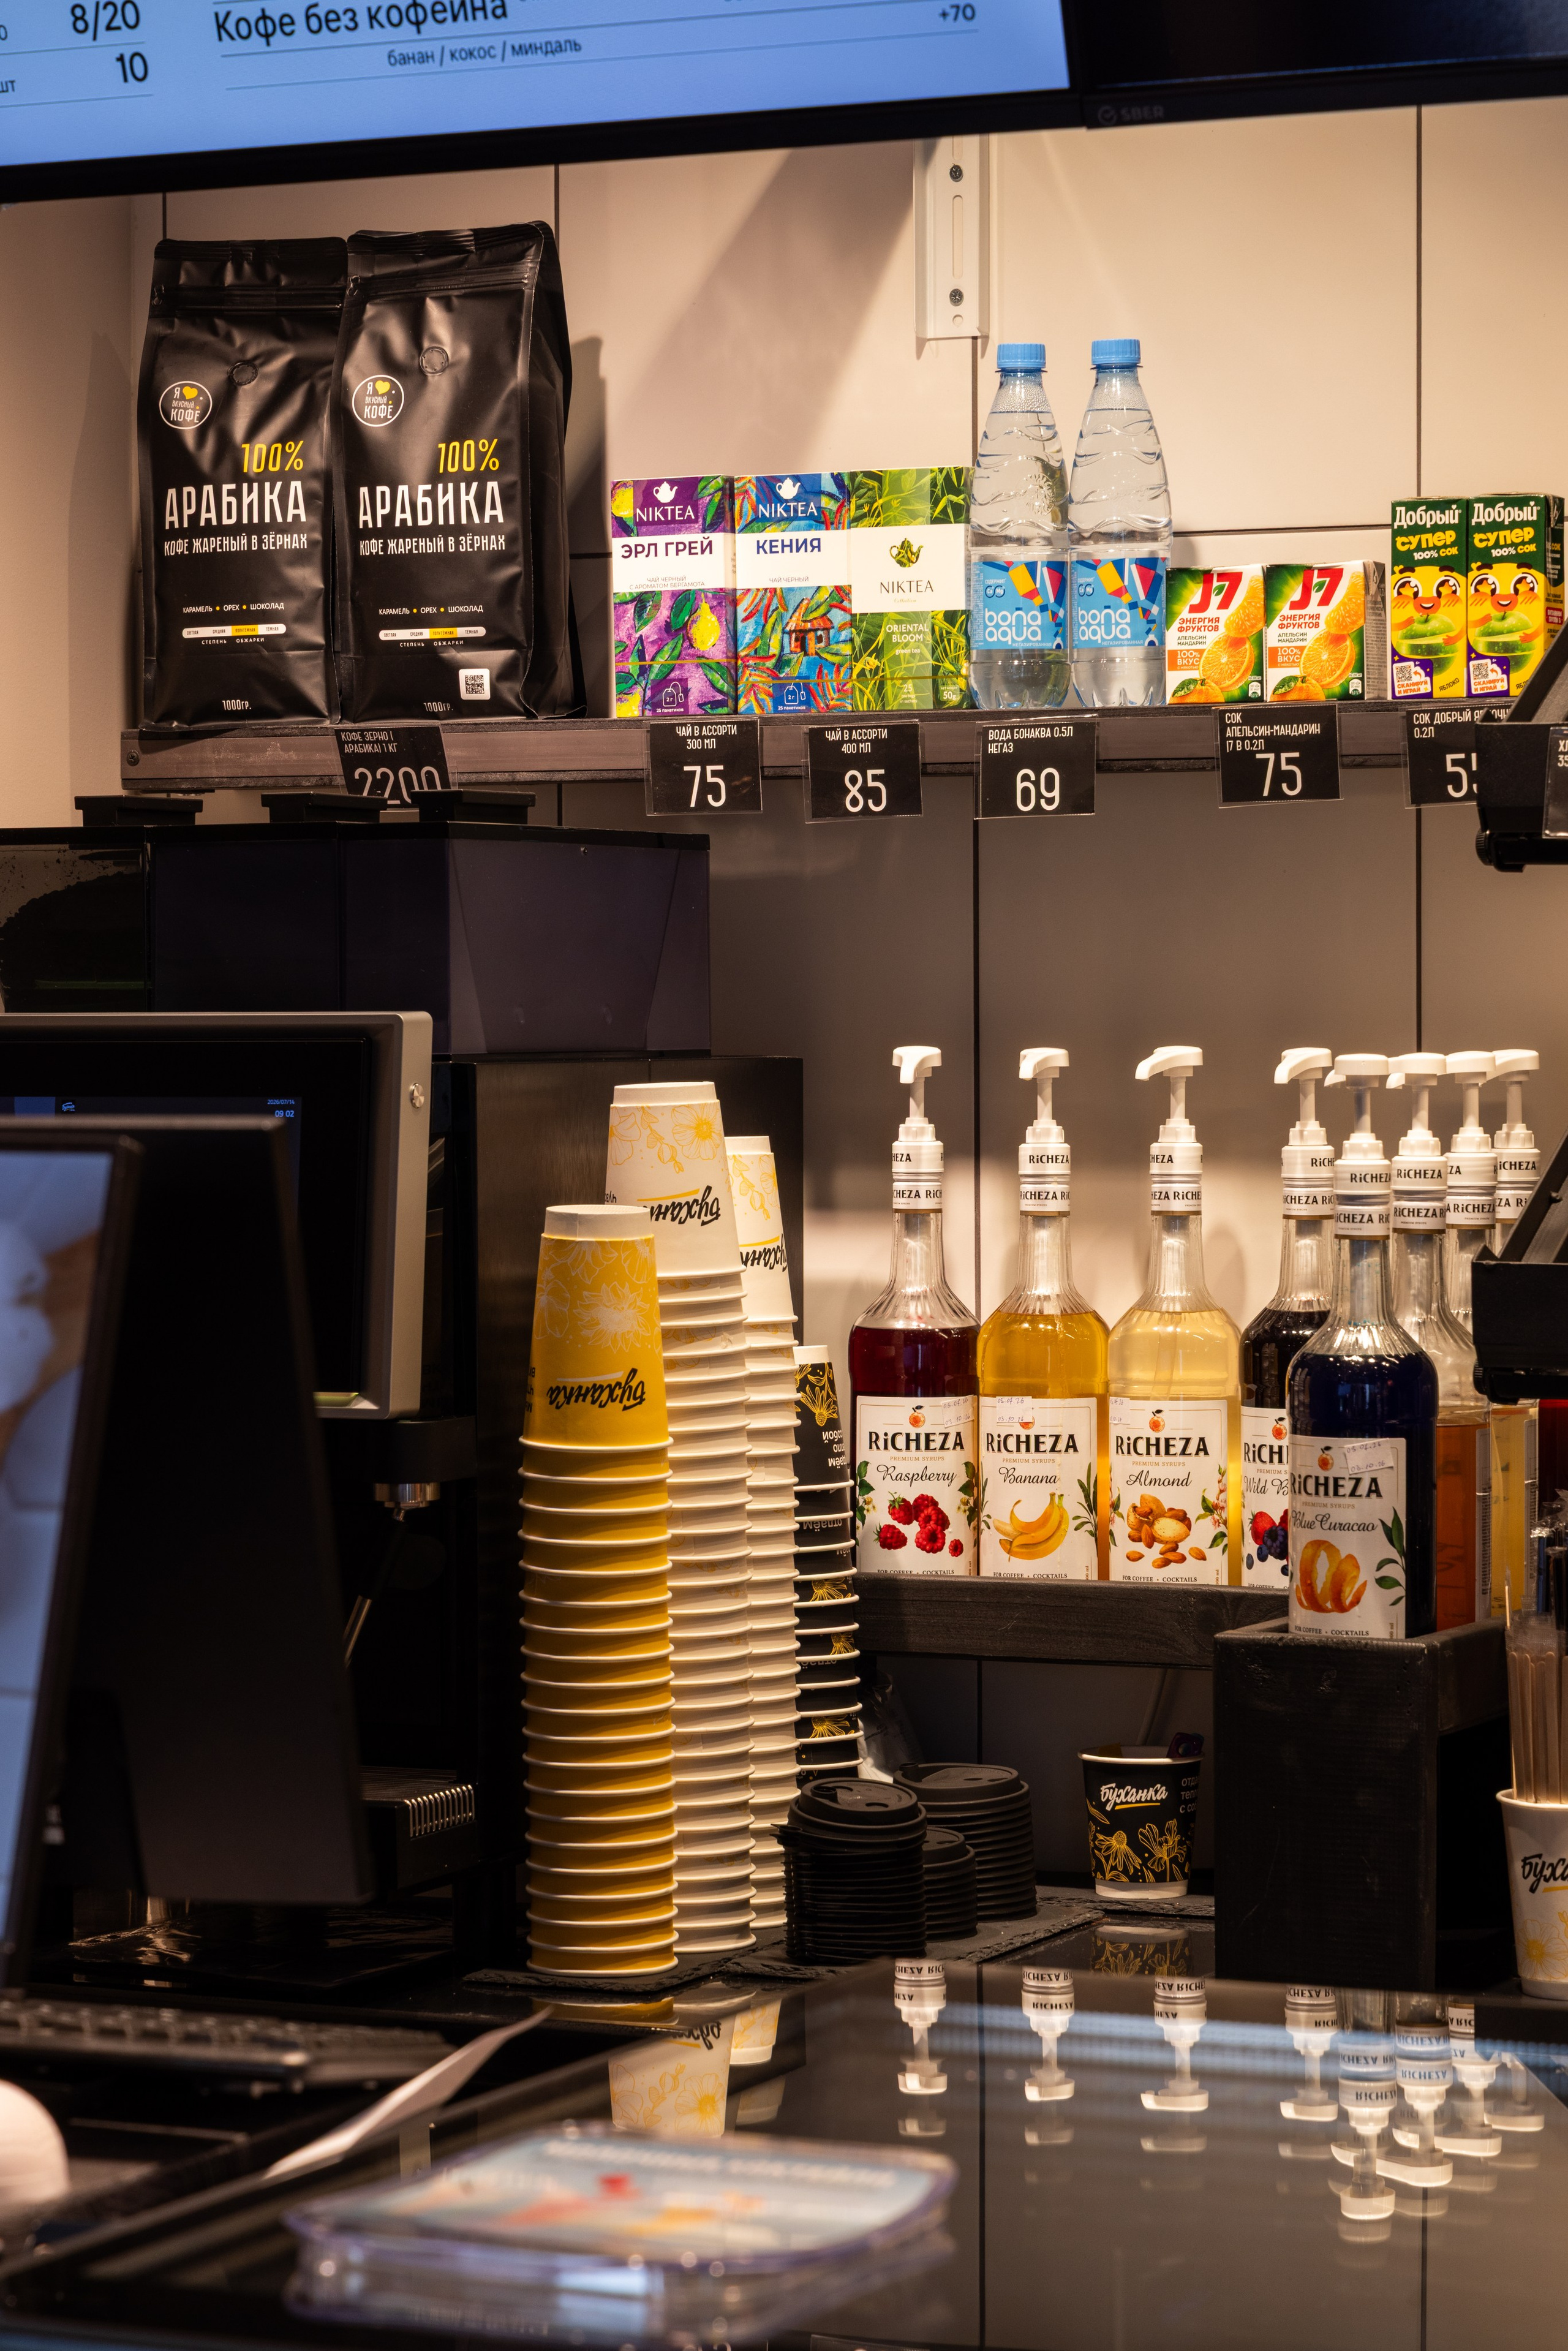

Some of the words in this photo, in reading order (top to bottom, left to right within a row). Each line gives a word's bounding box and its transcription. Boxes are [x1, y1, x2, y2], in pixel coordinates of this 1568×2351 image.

[70, 0, 141, 41] 8/20
[939, 2, 974, 23] +70
[214, 10, 296, 47] Кофе
[306, 2, 358, 34] без
[367, 0, 507, 34] кофеина
[388, 49, 435, 67] банан
[450, 44, 497, 62] кокос
[511, 38, 582, 58] миндаль
[116, 51, 148, 83] 10
[172, 399, 195, 409] ВКУСНЫЙ
[365, 395, 387, 404] ВКУСНЫЙ
[170, 408, 200, 423] КОФЕ
[364, 404, 393, 419] КОФЕ
[241, 440, 304, 473] 100%
[438, 439, 500, 474] 100%
[165, 480, 306, 530] АРАБИКА
[359, 481, 504, 529] АРАБИКА
[758, 502, 818, 518] NIKTEA
[1472, 501, 1537, 526] Добрый
[636, 505, 695, 523] NIKTEA
[1393, 504, 1460, 529] Добрый
[164, 538, 189, 556] КОФЕ
[192, 533, 247, 554] ЖАРЕНЫЙ
[252, 535, 258, 551] В
[262, 532, 307, 550] ЗЁРНАХ
[360, 538, 384, 556] КОФЕ
[388, 534, 444, 554] ЖАРЕНЫЙ
[448, 537, 455, 552] В
[459, 533, 505, 552] ЗЁРНАХ
[620, 542, 658, 559] ЭРЛ
[665, 536, 713, 557] ГРЕЙ
[756, 537, 821, 555] КЕНИЯ
[1491, 547, 1516, 557] 100%
[1413, 550, 1438, 560] 100%
[880, 579, 934, 594] NIKTEA
[1188, 572, 1243, 614] J7
[1289, 568, 1344, 610] J7
[250, 602, 285, 611] ШОКОЛАД
[985, 608, 1041, 625] bona
[1078, 606, 1131, 625] bona
[886, 623, 929, 633] ORIENTAL
[1079, 624, 1131, 643] aqua
[1278, 621, 1320, 630] ФРУКТОВ
[892, 633, 924, 643] BLOOM
[985, 626, 1041, 644] aqua
[1397, 679, 1428, 689] СКАНИРУЙ
[1439, 677, 1460, 692] ЯБЛОКО
[1474, 677, 1504, 687] СКАНИРУЙ
[1479, 684, 1498, 692] ИГРАЙ
[943, 691, 956, 700] 50g
[1226, 712, 1242, 723] СОК
[1414, 713, 1430, 724] СОК
[1434, 709, 1471, 725] ДОБРЫЙ
[341, 731, 363, 741] КОФЕ
[364, 731, 388, 741] ЗЕРНО
[676, 724, 692, 736] ЧАЙ
[695, 725, 699, 736] В
[702, 725, 737, 736] АССОРТИ
[825, 728, 842, 741] ЧАЙ
[844, 730, 849, 740] В
[852, 728, 888, 740] АССОРТИ
[989, 729, 1011, 741] ВОДА
[1014, 727, 1051, 739] БОНАКВА
[1054, 726, 1073, 738] 0.5Л
[1226, 723, 1321, 738] АПЕЛЬСИН-МАНДАРИН
[1414, 727, 1434, 738] 0.2Л
[344, 743, 382, 753] АРАБИКА)
[388, 743, 398, 753] КГ
[687, 739, 701, 749] 300
[704, 739, 716, 749] МЛ
[842, 743, 857, 753] 400
[859, 742, 871, 753] МЛ
[988, 742, 1014, 753] НЕГАЗ
[1236, 740, 1242, 751] В
[1245, 739, 1264, 750] 0.2Л
[1256, 752, 1302, 796] 75
[354, 766, 442, 804] 2200
[684, 765, 726, 807] 75
[845, 769, 887, 812] 85
[1016, 768, 1060, 812] 69
[1029, 1155, 1069, 1164] RiCHEZA
[1397, 1169, 1442, 1179] RiCHEZA
[1394, 1207, 1438, 1218] RiCHEZA
[869, 1431, 965, 1452] RiCHEZA
[986, 1433, 1079, 1454] RiCHEZA
[1115, 1435, 1210, 1457] RiCHEZA
[876, 1464, 957, 1487] Raspberry
[998, 1466, 1060, 1484] Banana
[1126, 1470, 1193, 1487] Almond
[1243, 1476, 1268, 1495] Wild
[1291, 1473, 1383, 1499] RiCHEZA
[1292, 1509, 1316, 1530] Blue
[1316, 1512, 1378, 1532] Curacao
